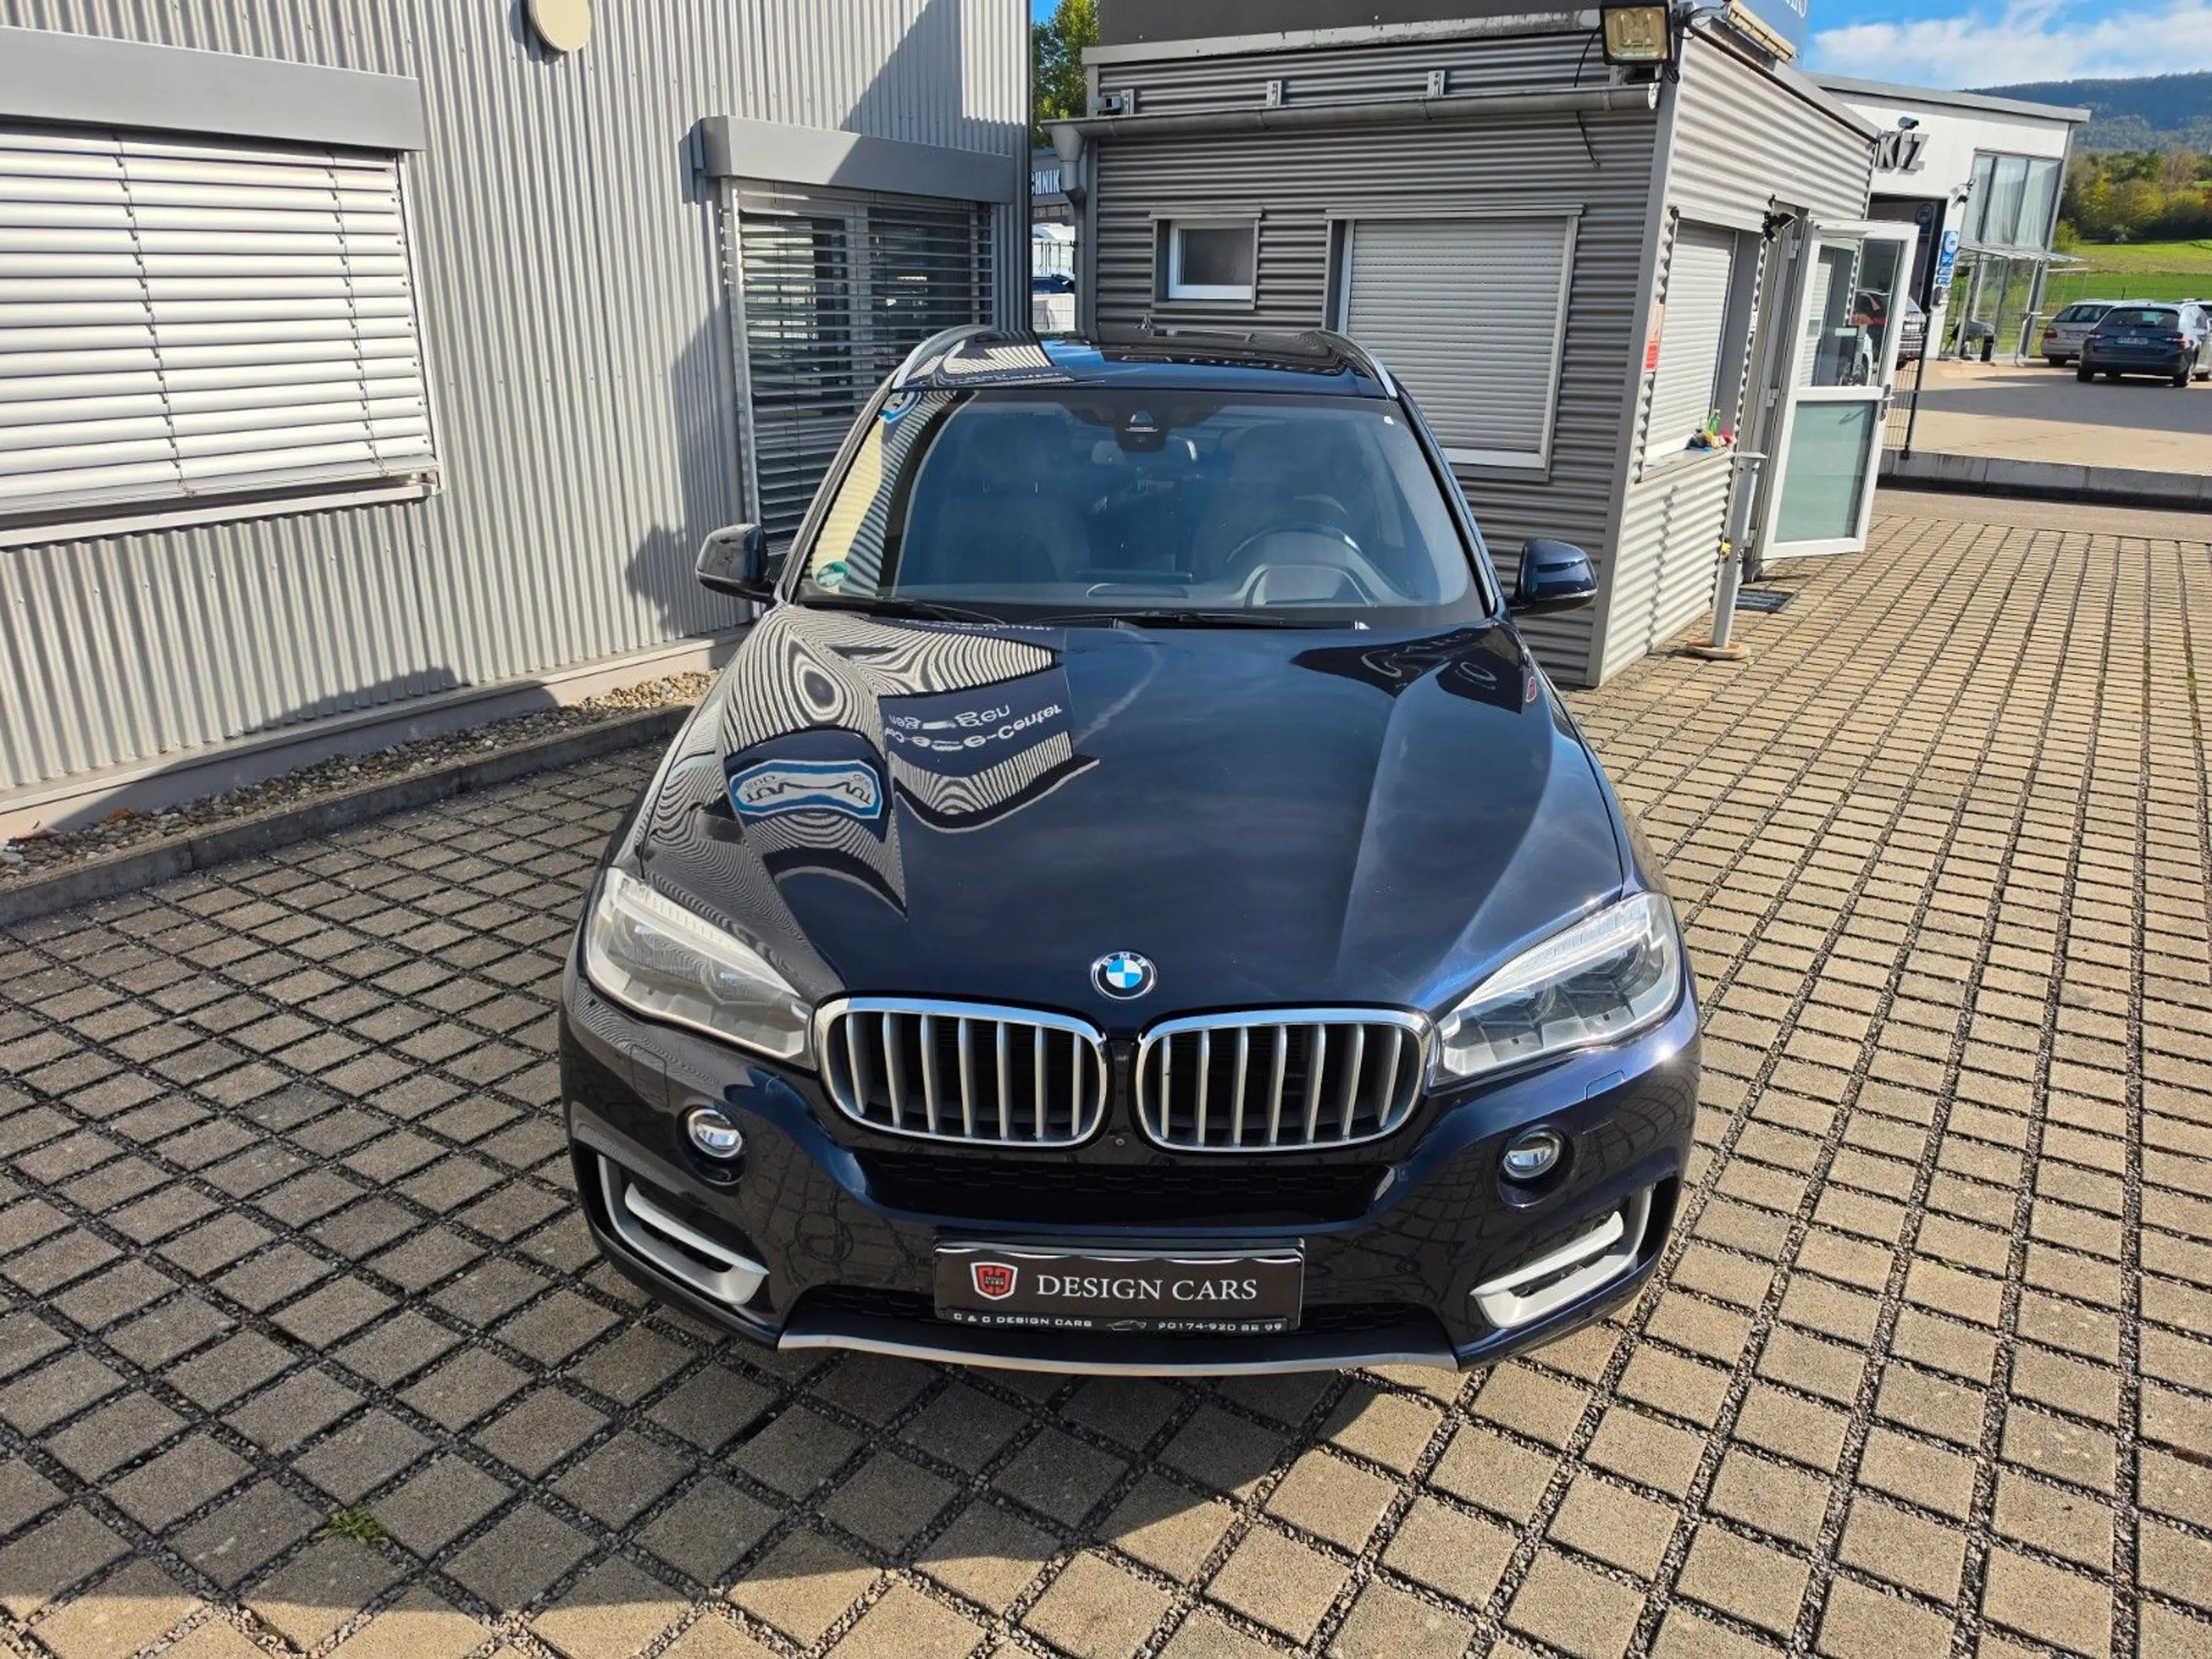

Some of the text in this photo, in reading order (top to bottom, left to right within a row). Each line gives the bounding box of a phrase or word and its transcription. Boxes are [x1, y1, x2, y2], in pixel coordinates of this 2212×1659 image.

[1036, 1274, 1257, 1301] DESIGN CARS
[967, 1315, 977, 1323] &
[997, 1316, 1050, 1325] DESIGN
[1055, 1318, 1093, 1328] CARS
